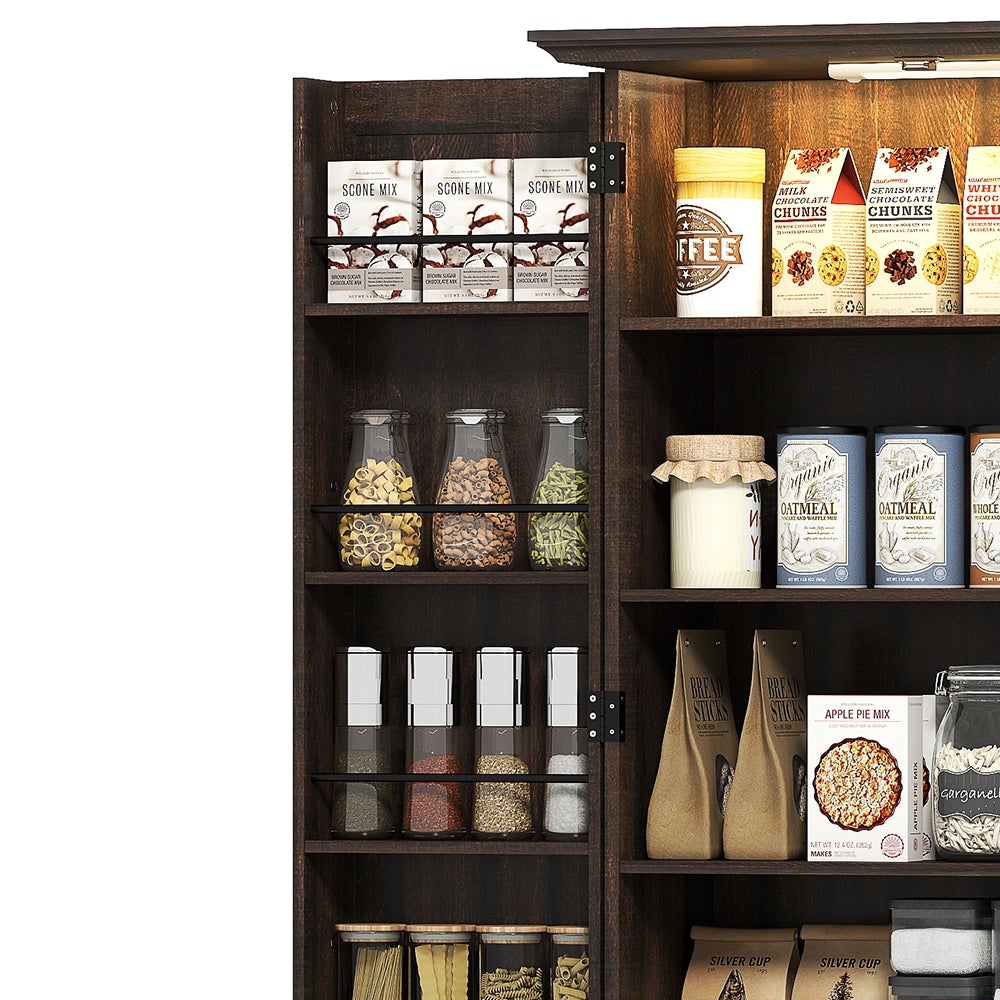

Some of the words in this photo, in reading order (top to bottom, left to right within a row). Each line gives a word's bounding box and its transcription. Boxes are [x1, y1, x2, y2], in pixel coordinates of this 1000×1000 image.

[343, 183, 374, 196] SCONE
[380, 183, 397, 196] MIX
[438, 182, 470, 195] SCONE
[475, 182, 493, 195] MIX
[528, 180, 561, 194] SCONE
[566, 180, 584, 193] MIX
[779, 187, 808, 195] MILK
[776, 197, 829, 205] CHOCOLATE
[774, 206, 826, 218] CHUNKS
[868, 205, 932, 216] CHUNKS
[676, 238, 736, 262] FFEE
[780, 456, 834, 499] Organic
[878, 455, 934, 499] Organic
[781, 502, 837, 515] OATMEAL
[879, 501, 936, 515] OATMEAL
[690, 677, 723, 698] BREAD
[767, 677, 801, 698] BREAD
[694, 700, 729, 722] STICKS
[770, 700, 806, 722] STICKS
[825, 709, 853, 719] APPLE
[856, 709, 870, 719] PIE
[873, 709, 890, 719] MIX
[710, 956, 746, 966] SILVER
[749, 956, 771, 966] CUP
[820, 958, 856, 968] SILVER
[859, 959, 881, 968] CUP
